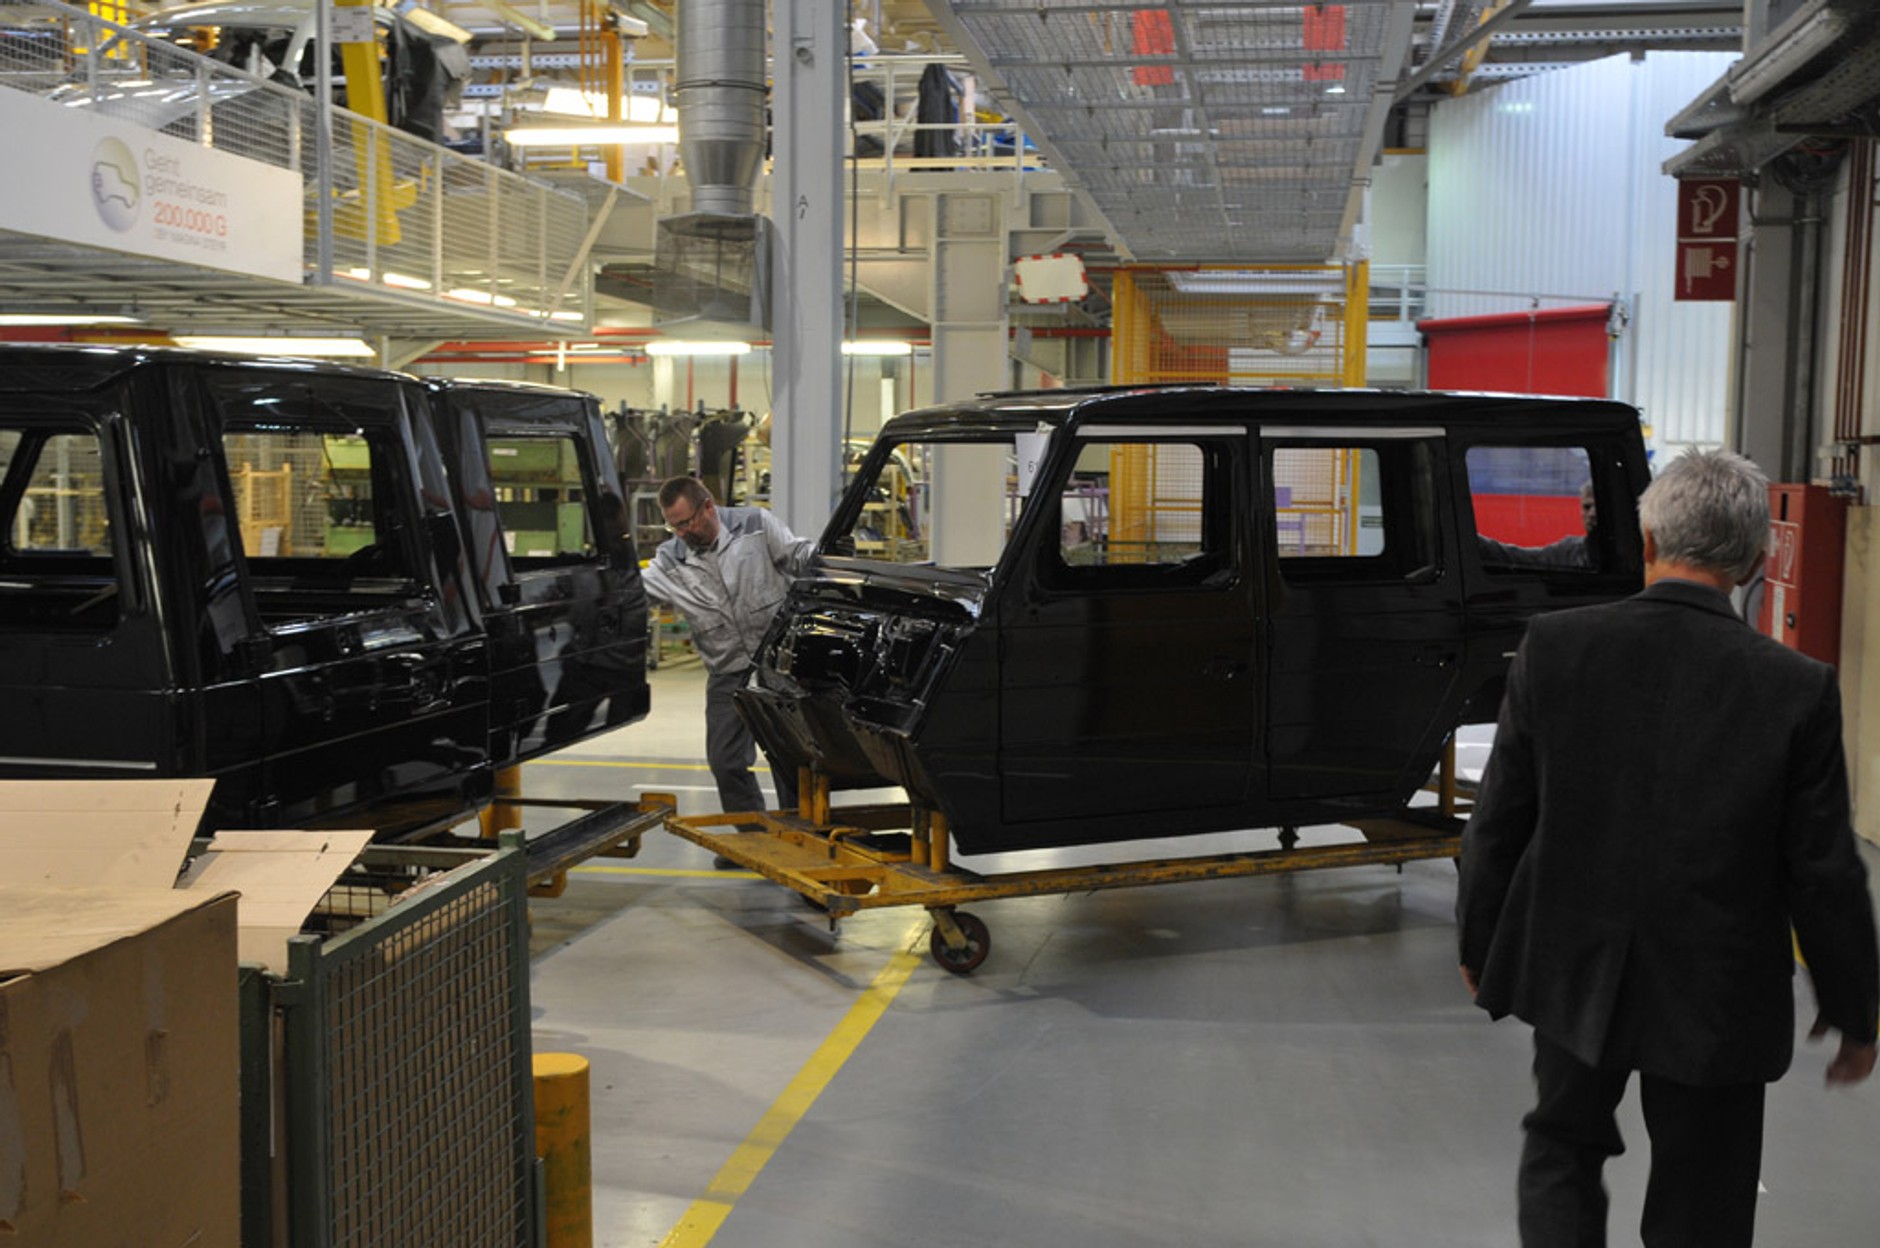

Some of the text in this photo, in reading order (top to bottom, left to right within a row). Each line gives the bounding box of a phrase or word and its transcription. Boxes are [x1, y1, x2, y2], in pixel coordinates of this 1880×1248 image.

[145, 174, 227, 208] gemeinsam
[154, 201, 228, 236] 200.000 G
